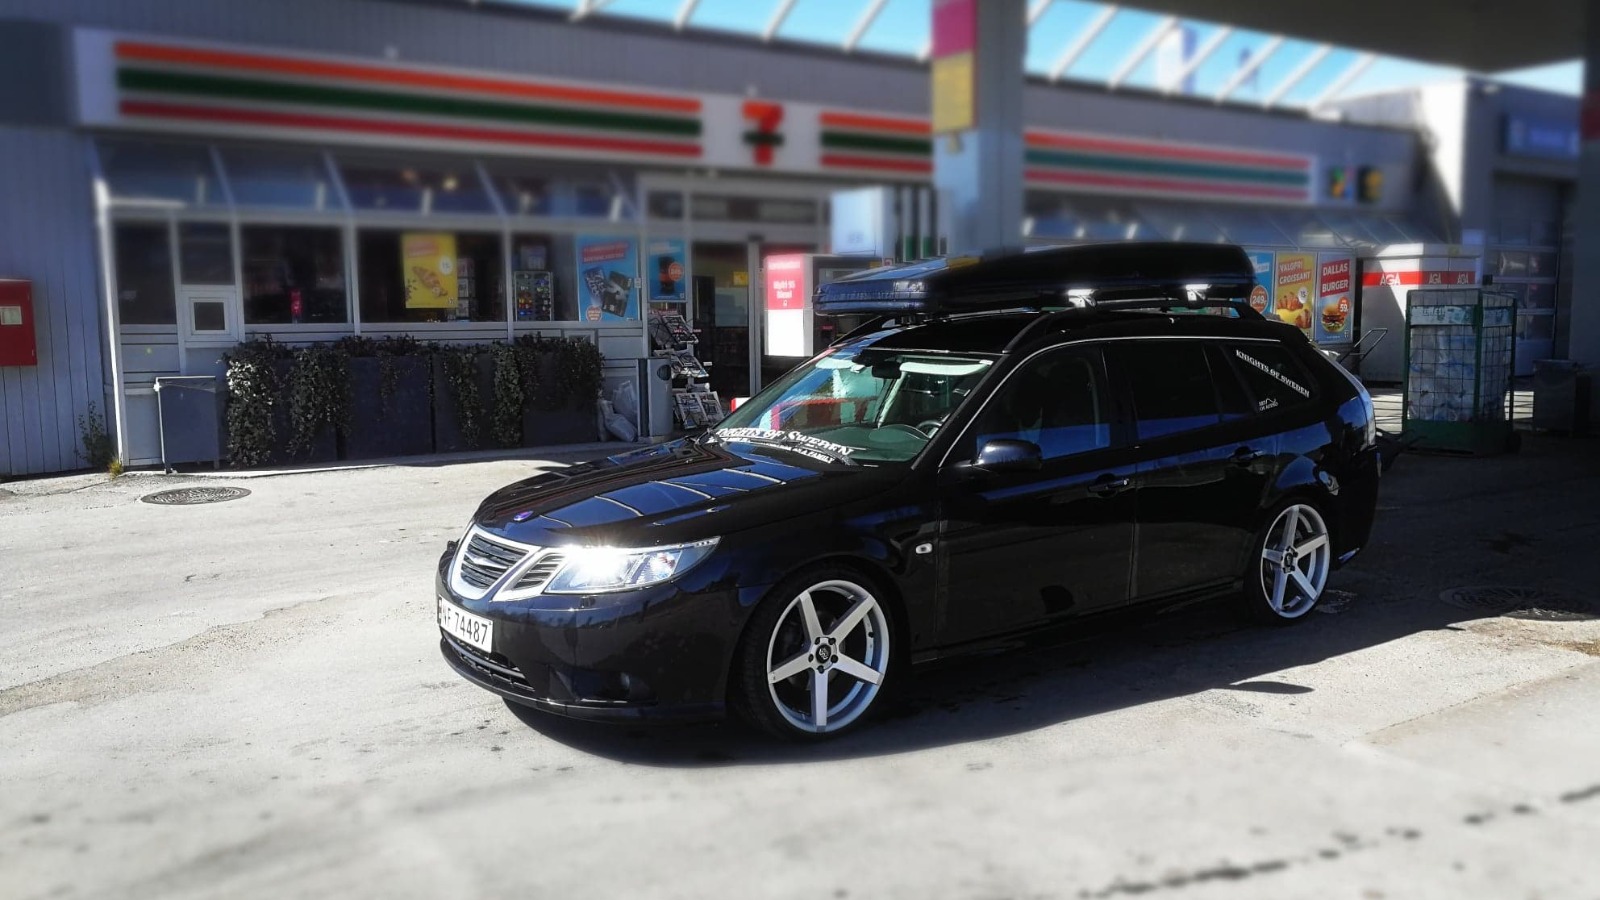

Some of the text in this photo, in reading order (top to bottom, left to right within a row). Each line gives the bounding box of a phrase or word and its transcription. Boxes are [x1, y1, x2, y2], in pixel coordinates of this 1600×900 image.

[741, 99, 784, 166] 7
[1322, 263, 1348, 276] DALLAS
[1279, 271, 1311, 285] CROISSANT
[1379, 272, 1401, 286] AGA
[1428, 272, 1442, 284] AGA
[1456, 272, 1469, 284] AGA
[1322, 279, 1349, 293] BURGER
[1235, 349, 1310, 398] KNIGHTS OF SWEDEN
[763, 429, 785, 440] OF
[808, 450, 836, 464] FAMILY
[454, 611, 488, 645] 74487
